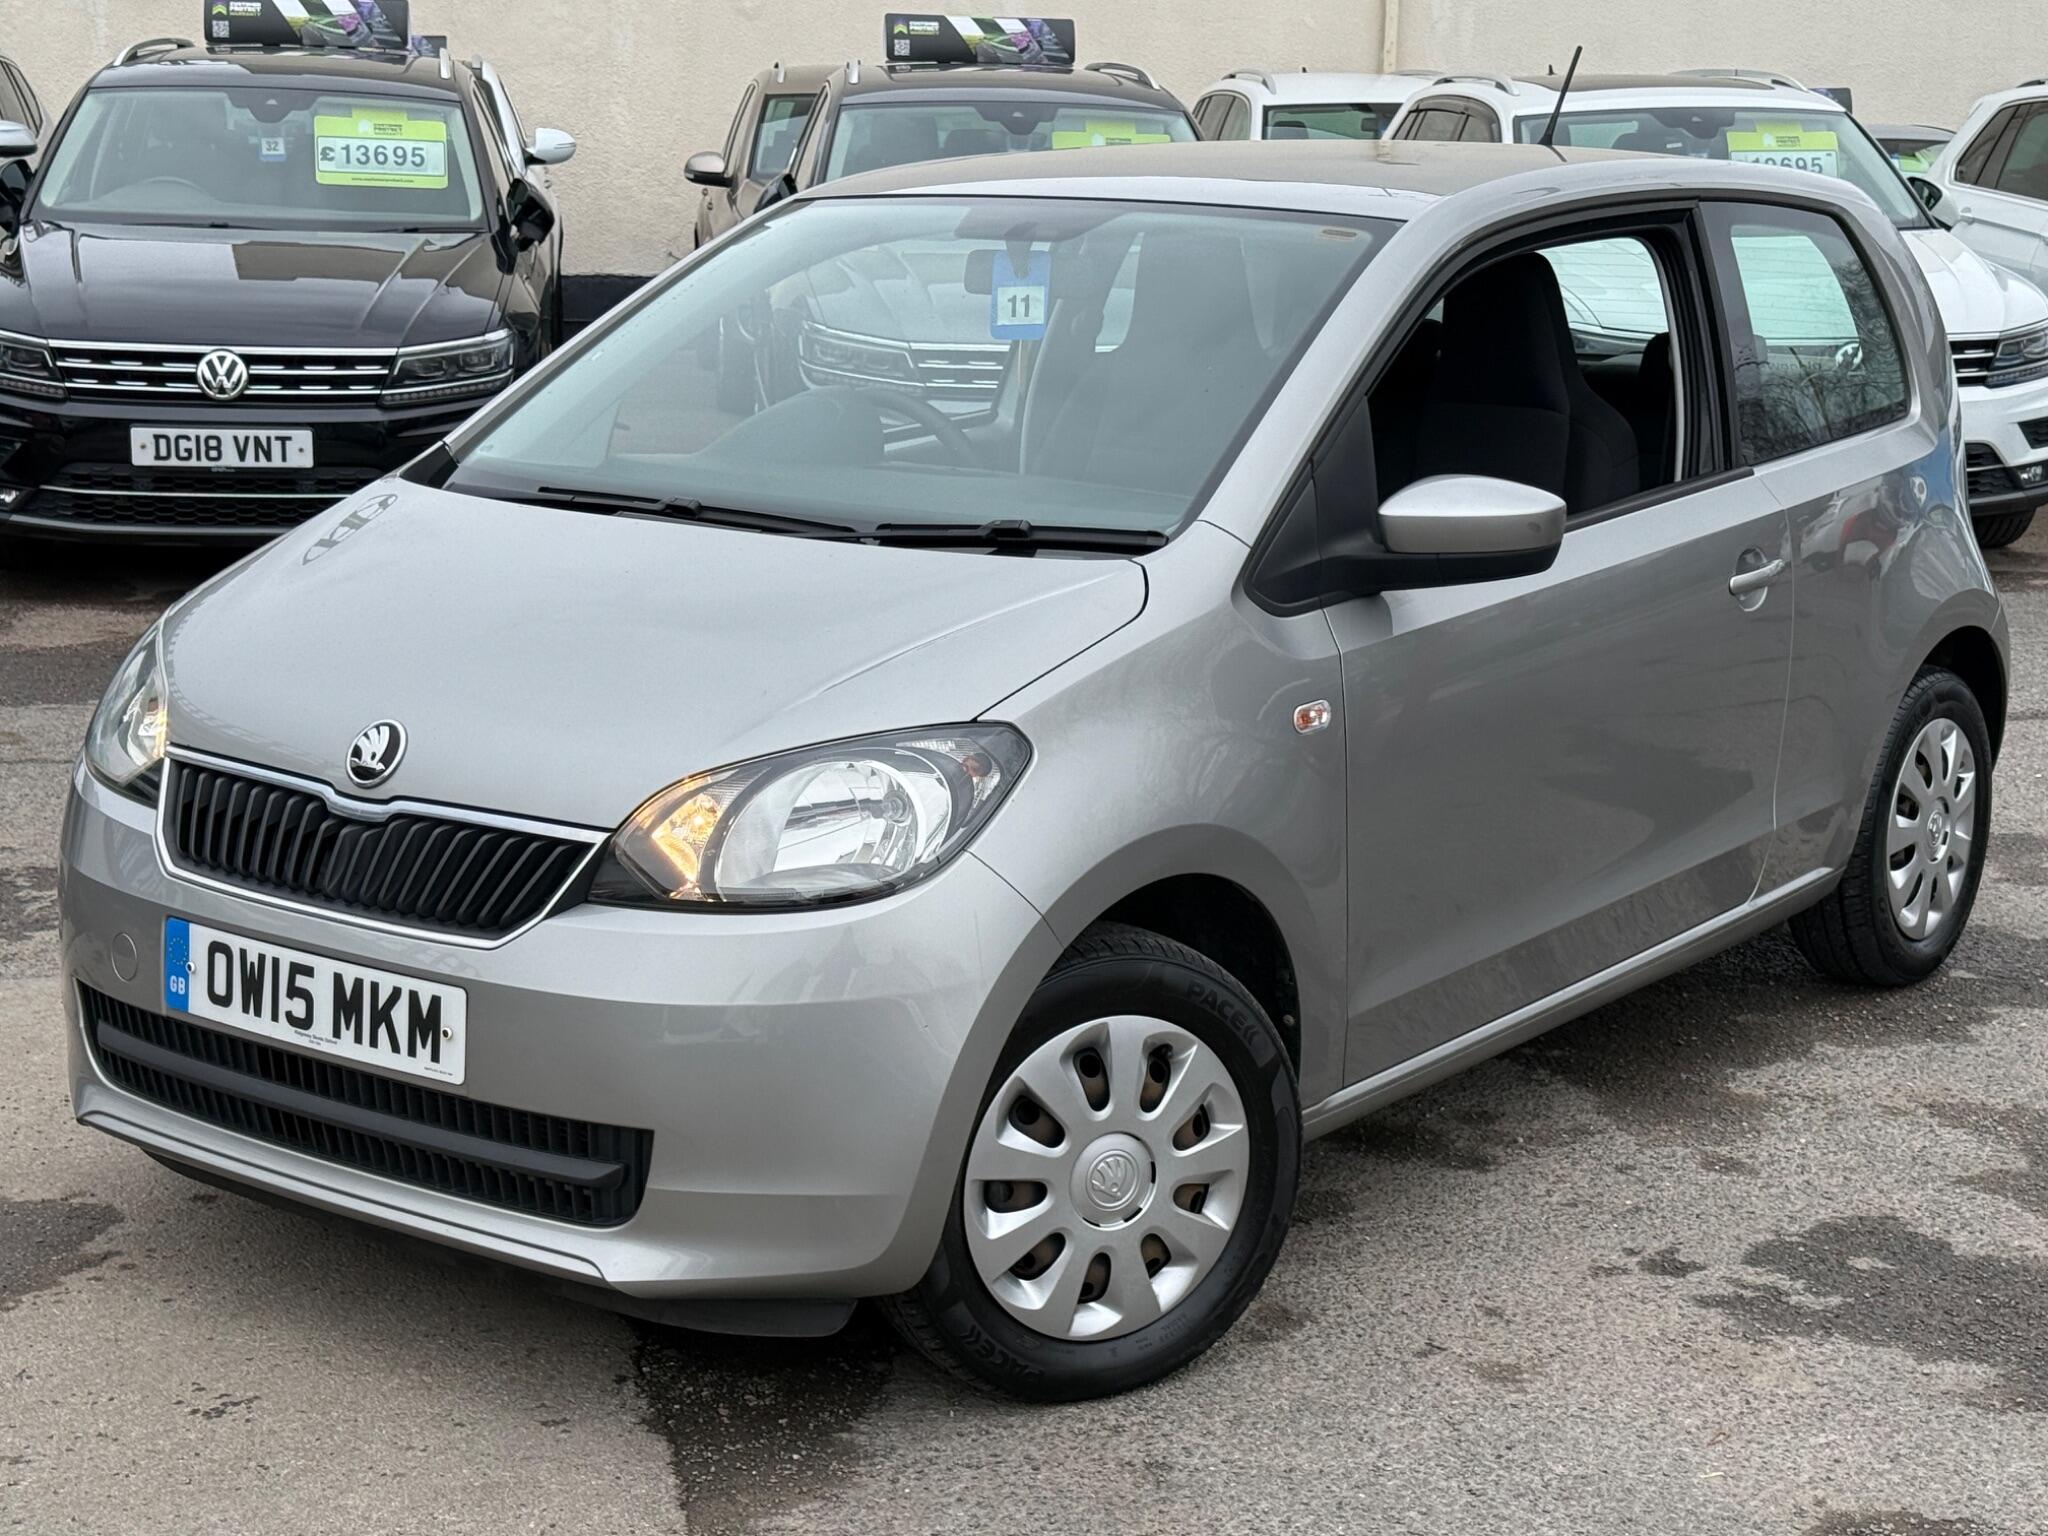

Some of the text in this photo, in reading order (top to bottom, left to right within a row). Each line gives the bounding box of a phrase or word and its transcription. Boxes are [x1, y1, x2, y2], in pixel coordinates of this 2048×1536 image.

[265, 140, 279, 152] 32
[320, 144, 426, 167] £13695
[1007, 294, 1030, 318] 11
[152, 434, 293, 463] DG18 VNT
[170, 975, 186, 994] GB
[207, 940, 442, 1064] OW15 MKM
